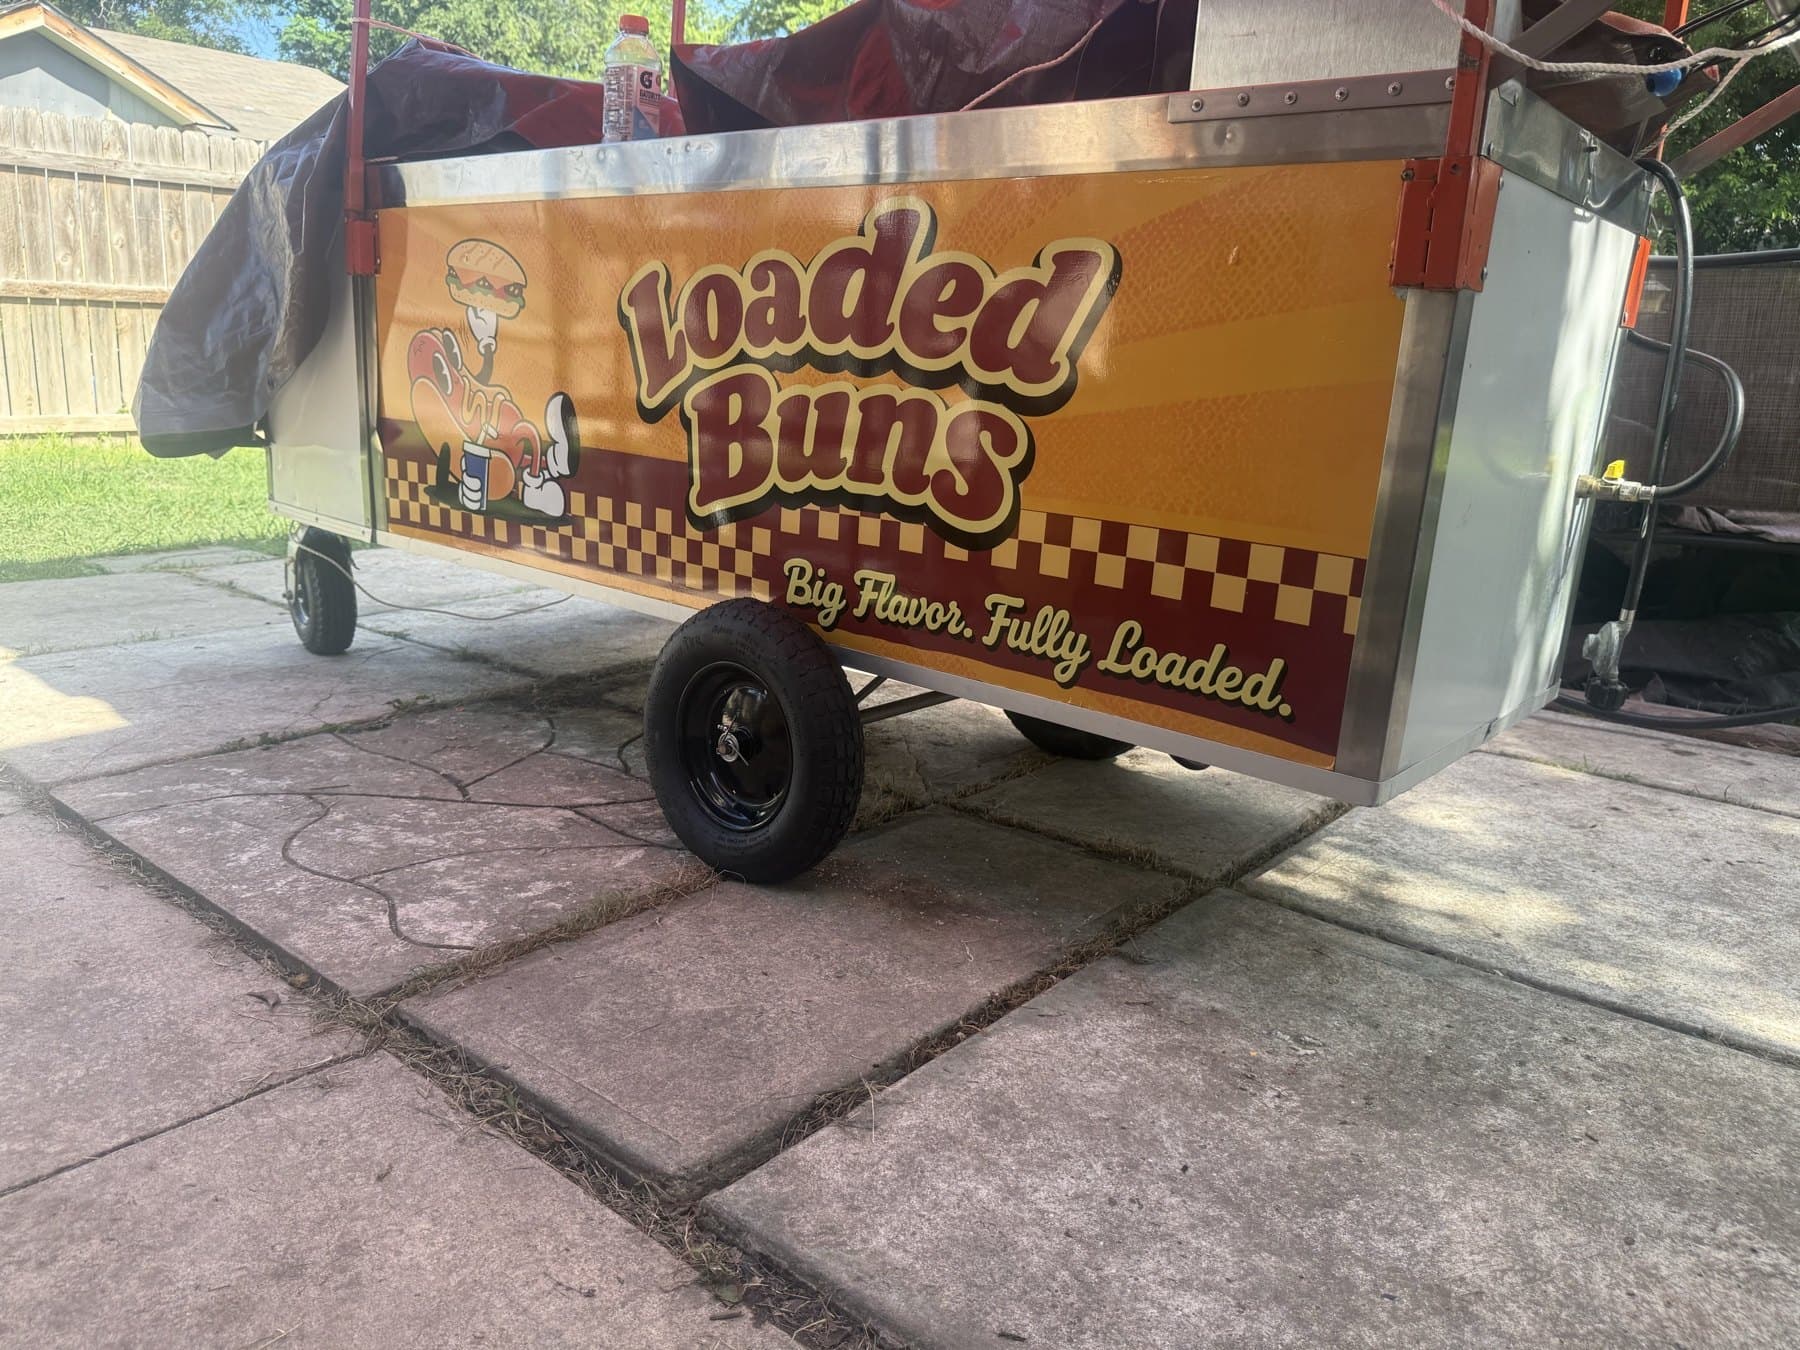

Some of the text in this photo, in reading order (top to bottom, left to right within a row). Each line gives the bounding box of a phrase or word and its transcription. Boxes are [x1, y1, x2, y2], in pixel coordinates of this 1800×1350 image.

[628, 209, 1103, 397] Loaded
[691, 374, 1018, 521] Buns
[783, 558, 1293, 716] Big Flavor. Fully Loaded.
